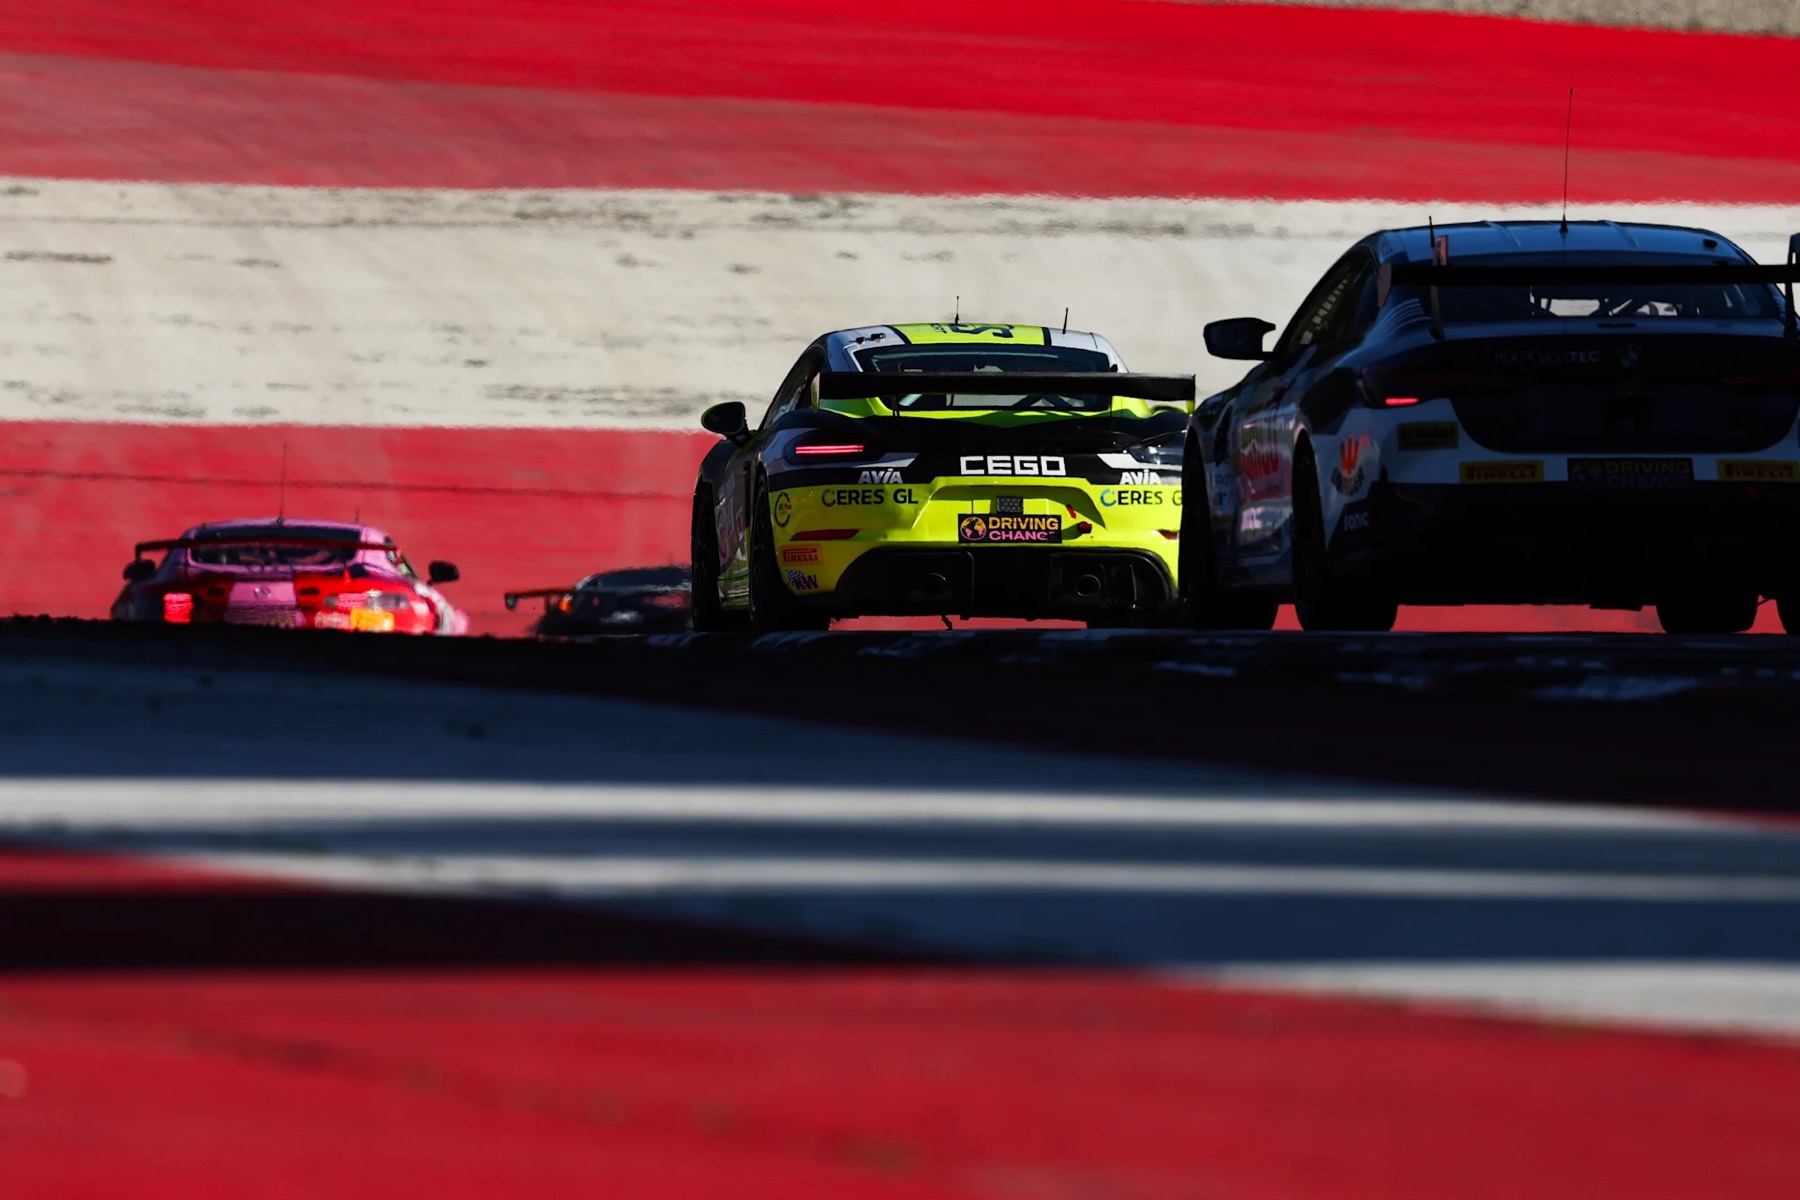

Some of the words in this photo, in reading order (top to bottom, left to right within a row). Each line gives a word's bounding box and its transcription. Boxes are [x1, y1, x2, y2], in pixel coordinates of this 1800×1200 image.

[960, 455, 1066, 476] CEGO
[1605, 461, 1690, 474] DRIVING
[822, 488, 884, 507] CERES
[893, 489, 918, 504] GL
[1100, 489, 1163, 507] CERES
[988, 517, 1060, 530] DRIVING
[988, 531, 1060, 541] CHANG
[783, 548, 818, 562] PIRELLI
